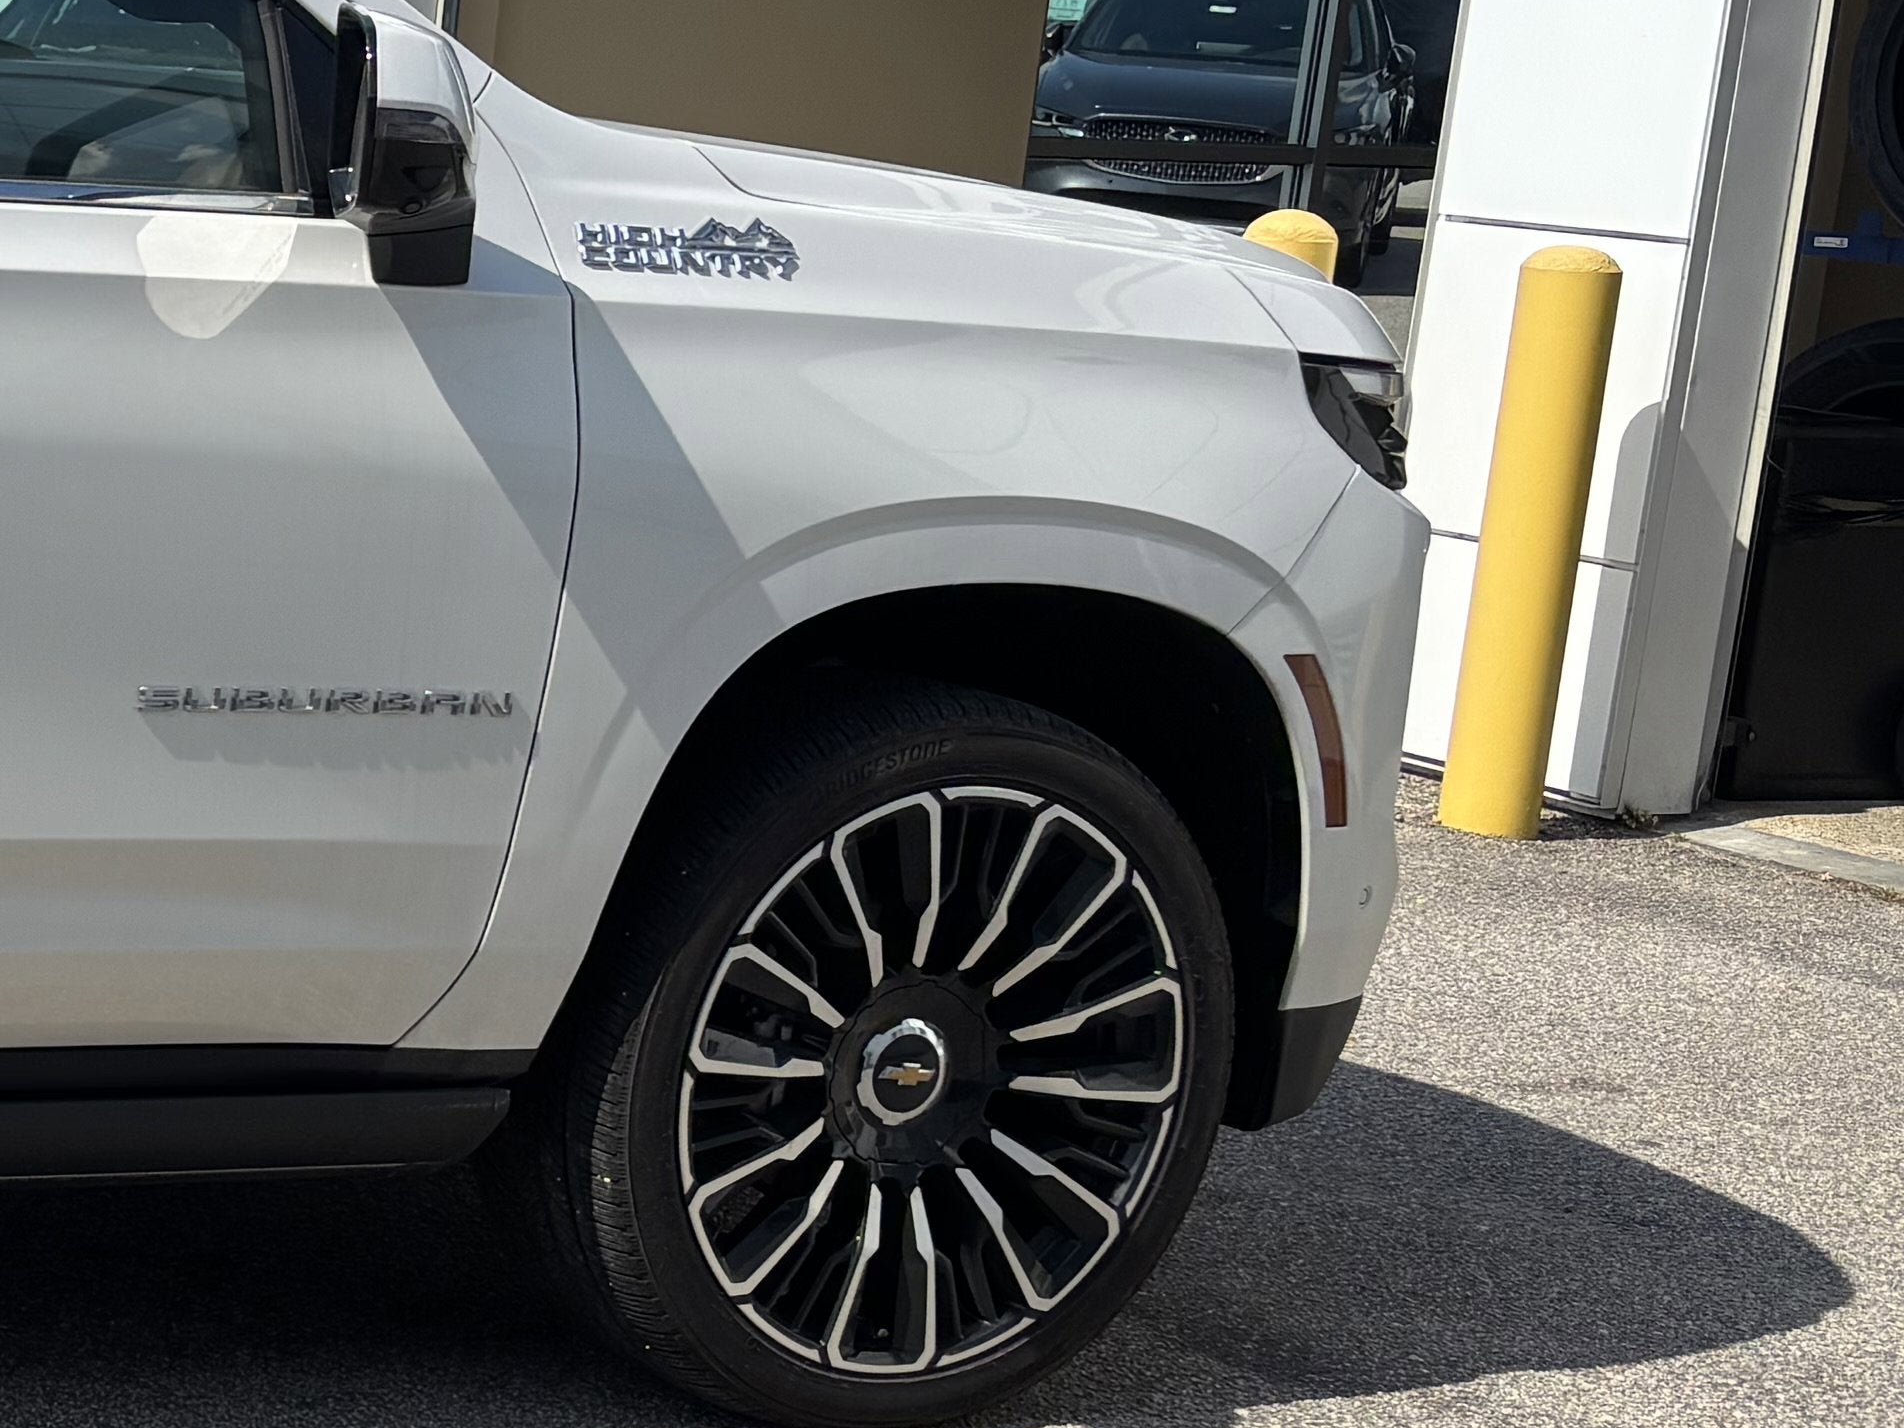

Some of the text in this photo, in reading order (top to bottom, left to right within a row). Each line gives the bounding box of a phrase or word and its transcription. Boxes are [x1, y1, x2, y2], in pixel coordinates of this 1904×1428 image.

[575, 223, 687, 248] HIGH
[578, 245, 799, 280] COUNTRY
[137, 684, 514, 718] SUBURBAN
